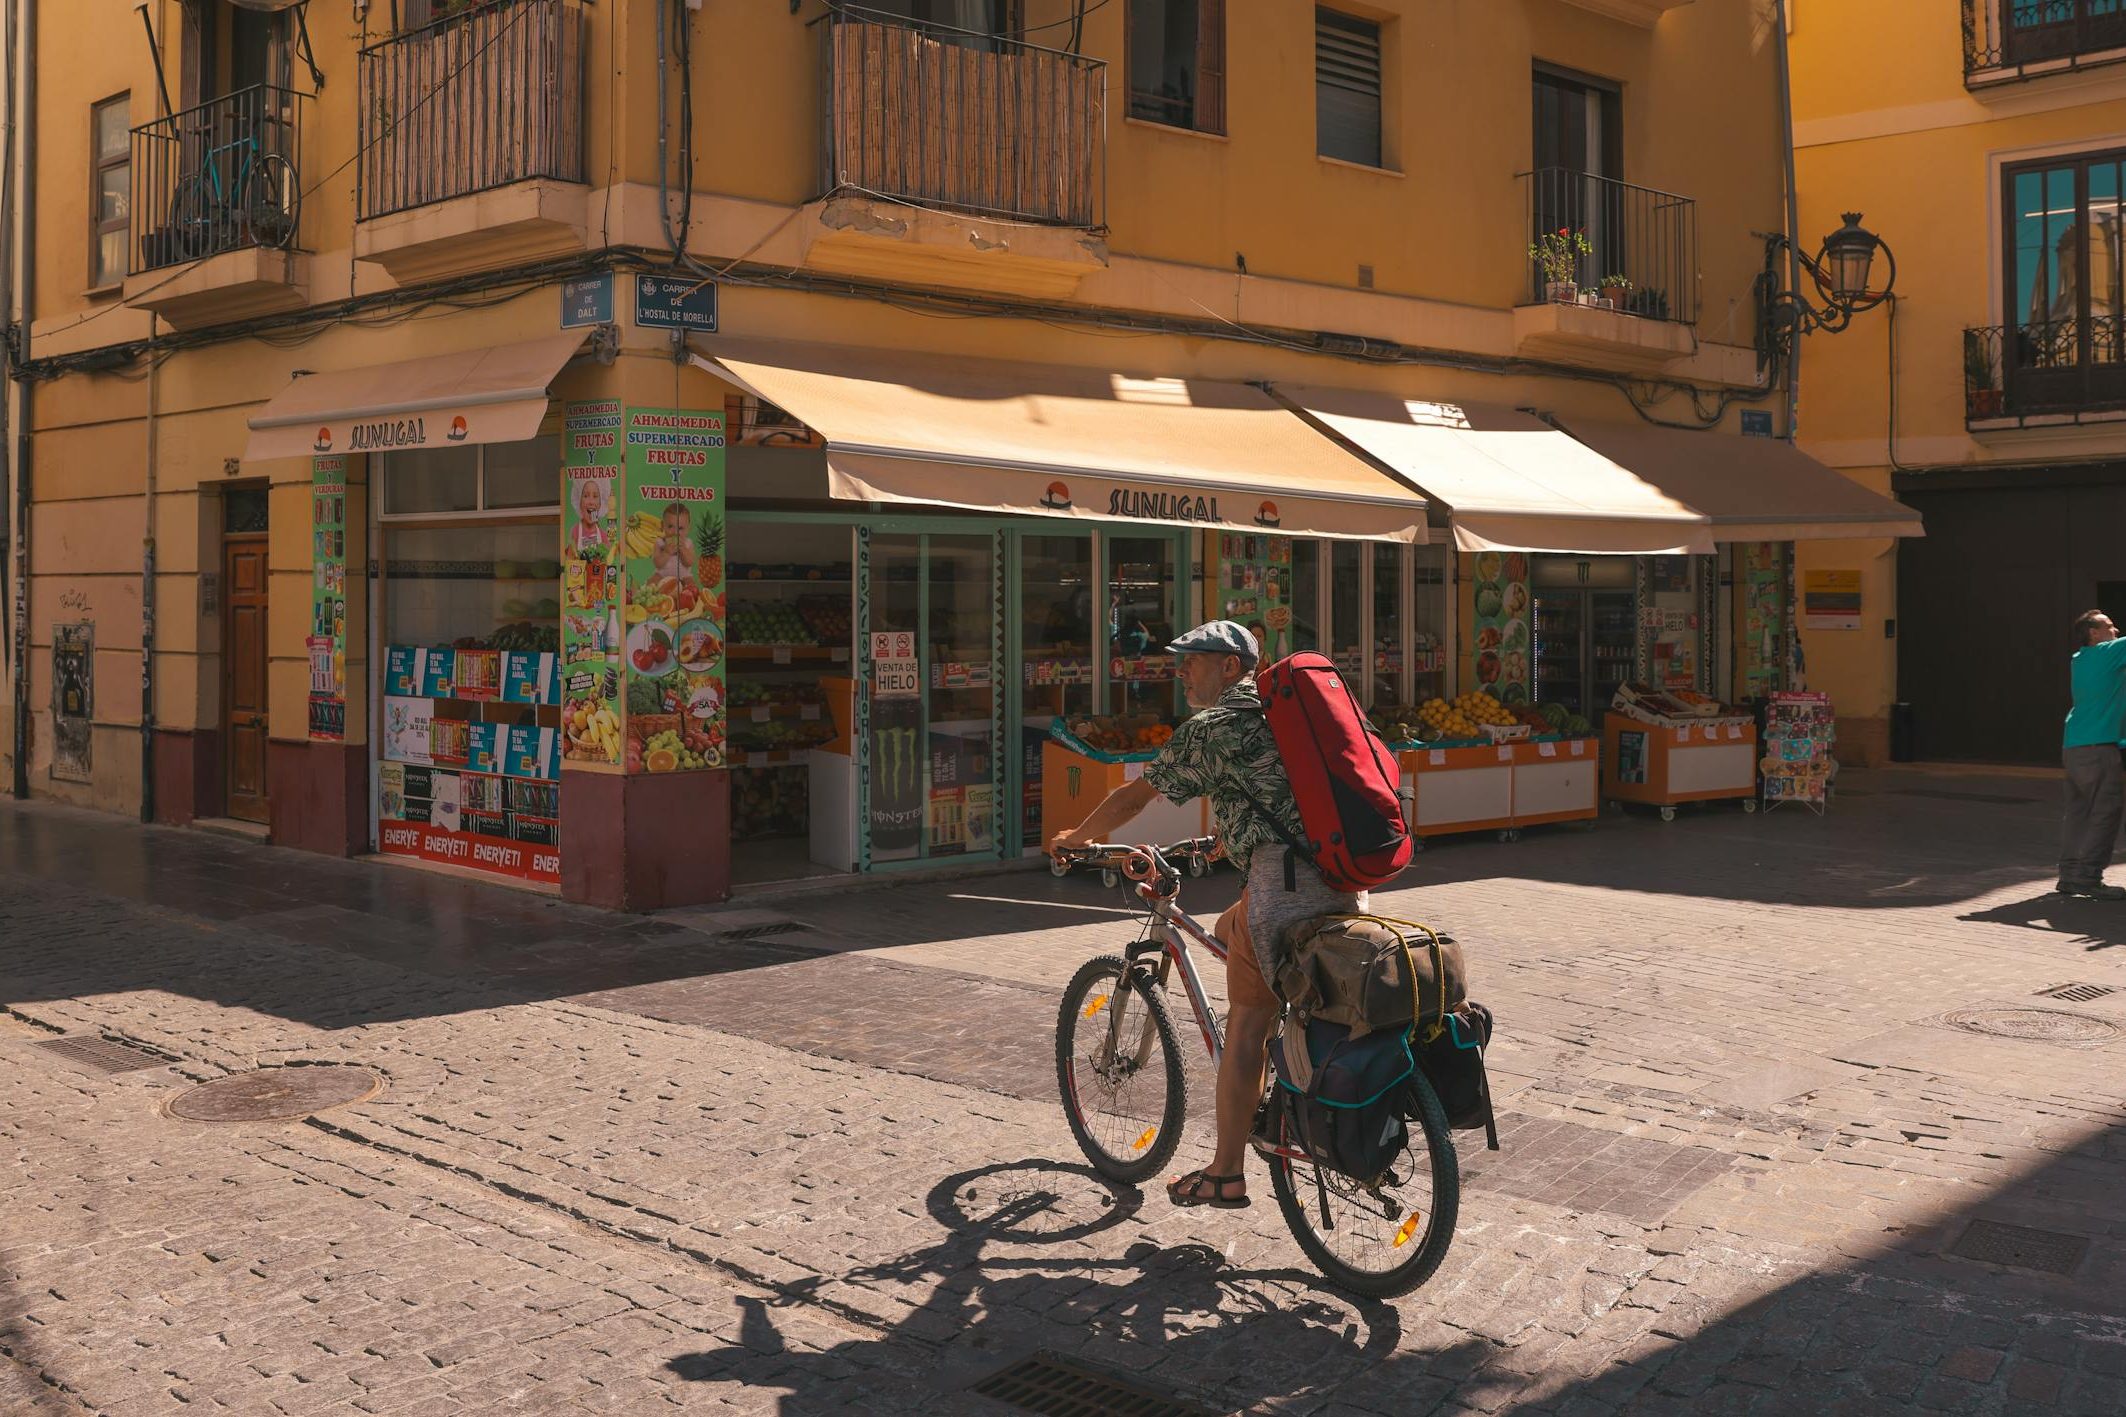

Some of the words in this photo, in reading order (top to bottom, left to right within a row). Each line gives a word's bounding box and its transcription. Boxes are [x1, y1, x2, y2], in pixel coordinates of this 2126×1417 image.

[578, 280, 602, 290] CARRER
[584, 295, 593, 304] DE
[670, 298, 683, 307] DE
[577, 306, 597, 319] DALT
[639, 308, 670, 321] L'HOSTAL
[671, 311, 681, 321] DE
[683, 312, 714, 325] MORELLA
[567, 403, 619, 416] AHMADMEDIA
[565, 416, 622, 430] SUPERMERCADO
[631, 414, 722, 431] AHMADMEDIA
[350, 417, 427, 450] SUNUGAL
[574, 433, 615, 449] FRUTAS
[628, 432, 725, 448] SUPERMERCADO
[587, 450, 596, 465] Y
[647, 449, 707, 467] FRUTAS
[315, 460, 344, 473] FRUTAS
[567, 465, 618, 481] VERDURAS
[670, 469, 683, 483] Y
[313, 484, 345, 496] VERDURAS
[640, 486, 715, 501] VERDURAS
[1107, 488, 1223, 521] SUNUGAL
[877, 663, 904, 672] VENTA
[905, 662, 917, 672] DE
[878, 674, 915, 690] HIELO
[384, 828, 420, 849] ENERYE
[424, 835, 468, 858] ENERYETI
[473, 843, 522, 868] ENERYETI
